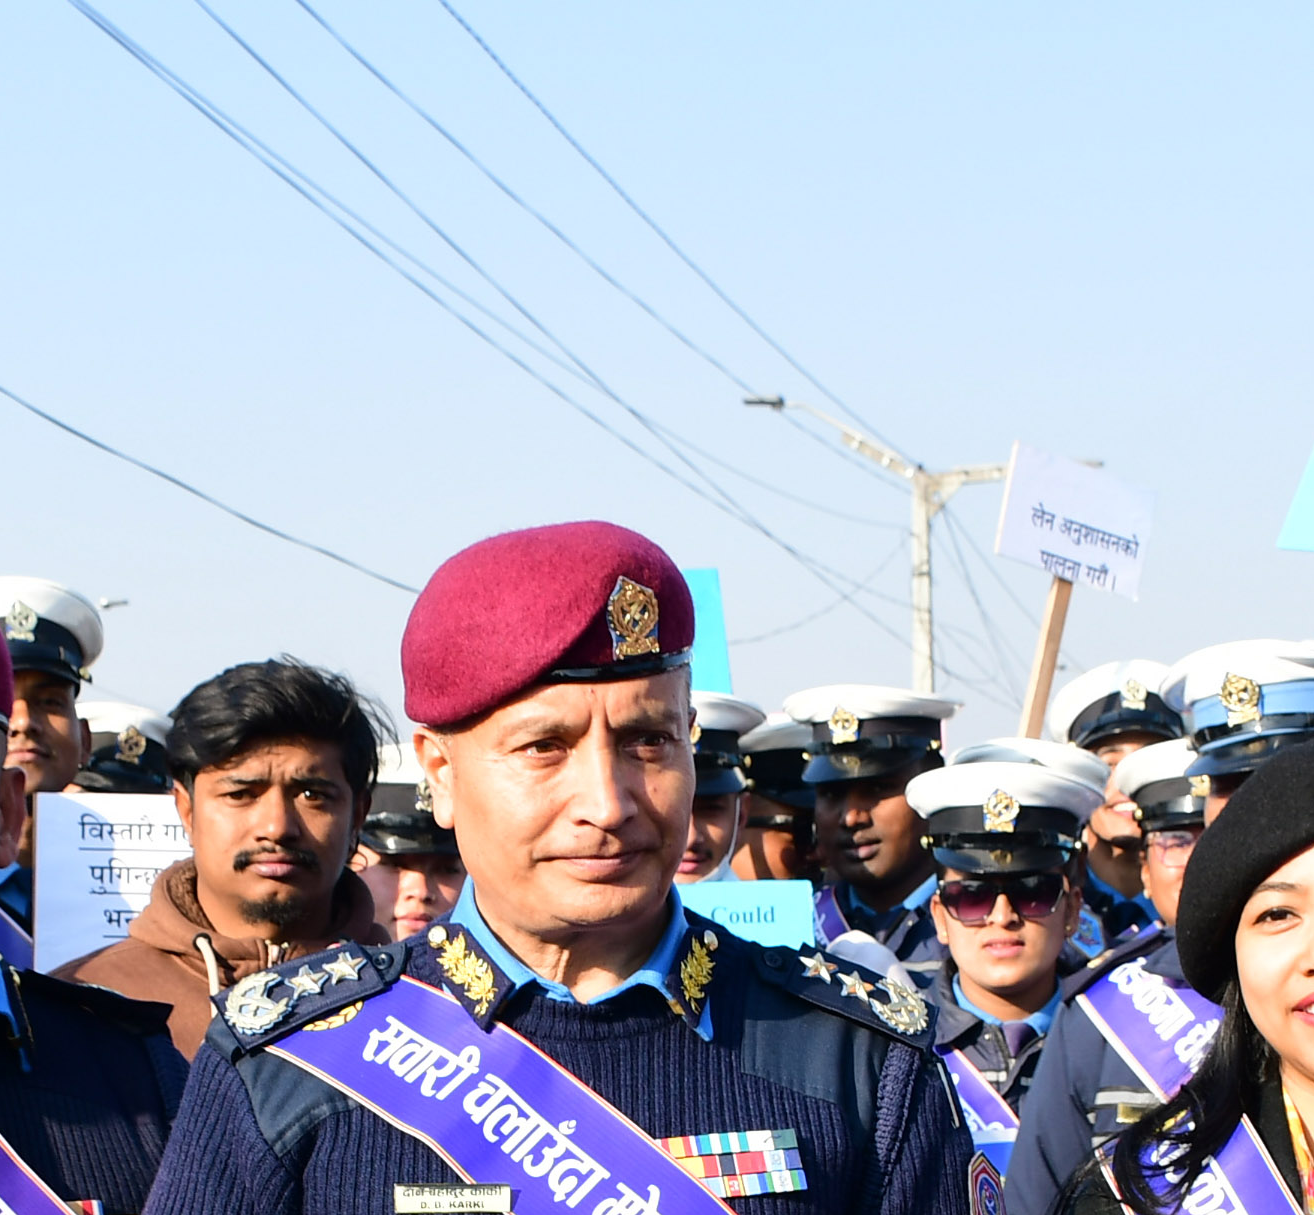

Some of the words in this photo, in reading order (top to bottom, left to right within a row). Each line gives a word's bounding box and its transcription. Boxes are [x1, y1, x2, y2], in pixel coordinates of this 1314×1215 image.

[1031, 502, 1056, 531] लेन
[1059, 517, 1140, 559] अनुशासनको
[1040, 549, 1082, 580] पालना
[710, 905, 776, 924] Could
[362, 1015, 482, 1102] सवारी
[462, 1073, 610, 1209] चलाउँदा
